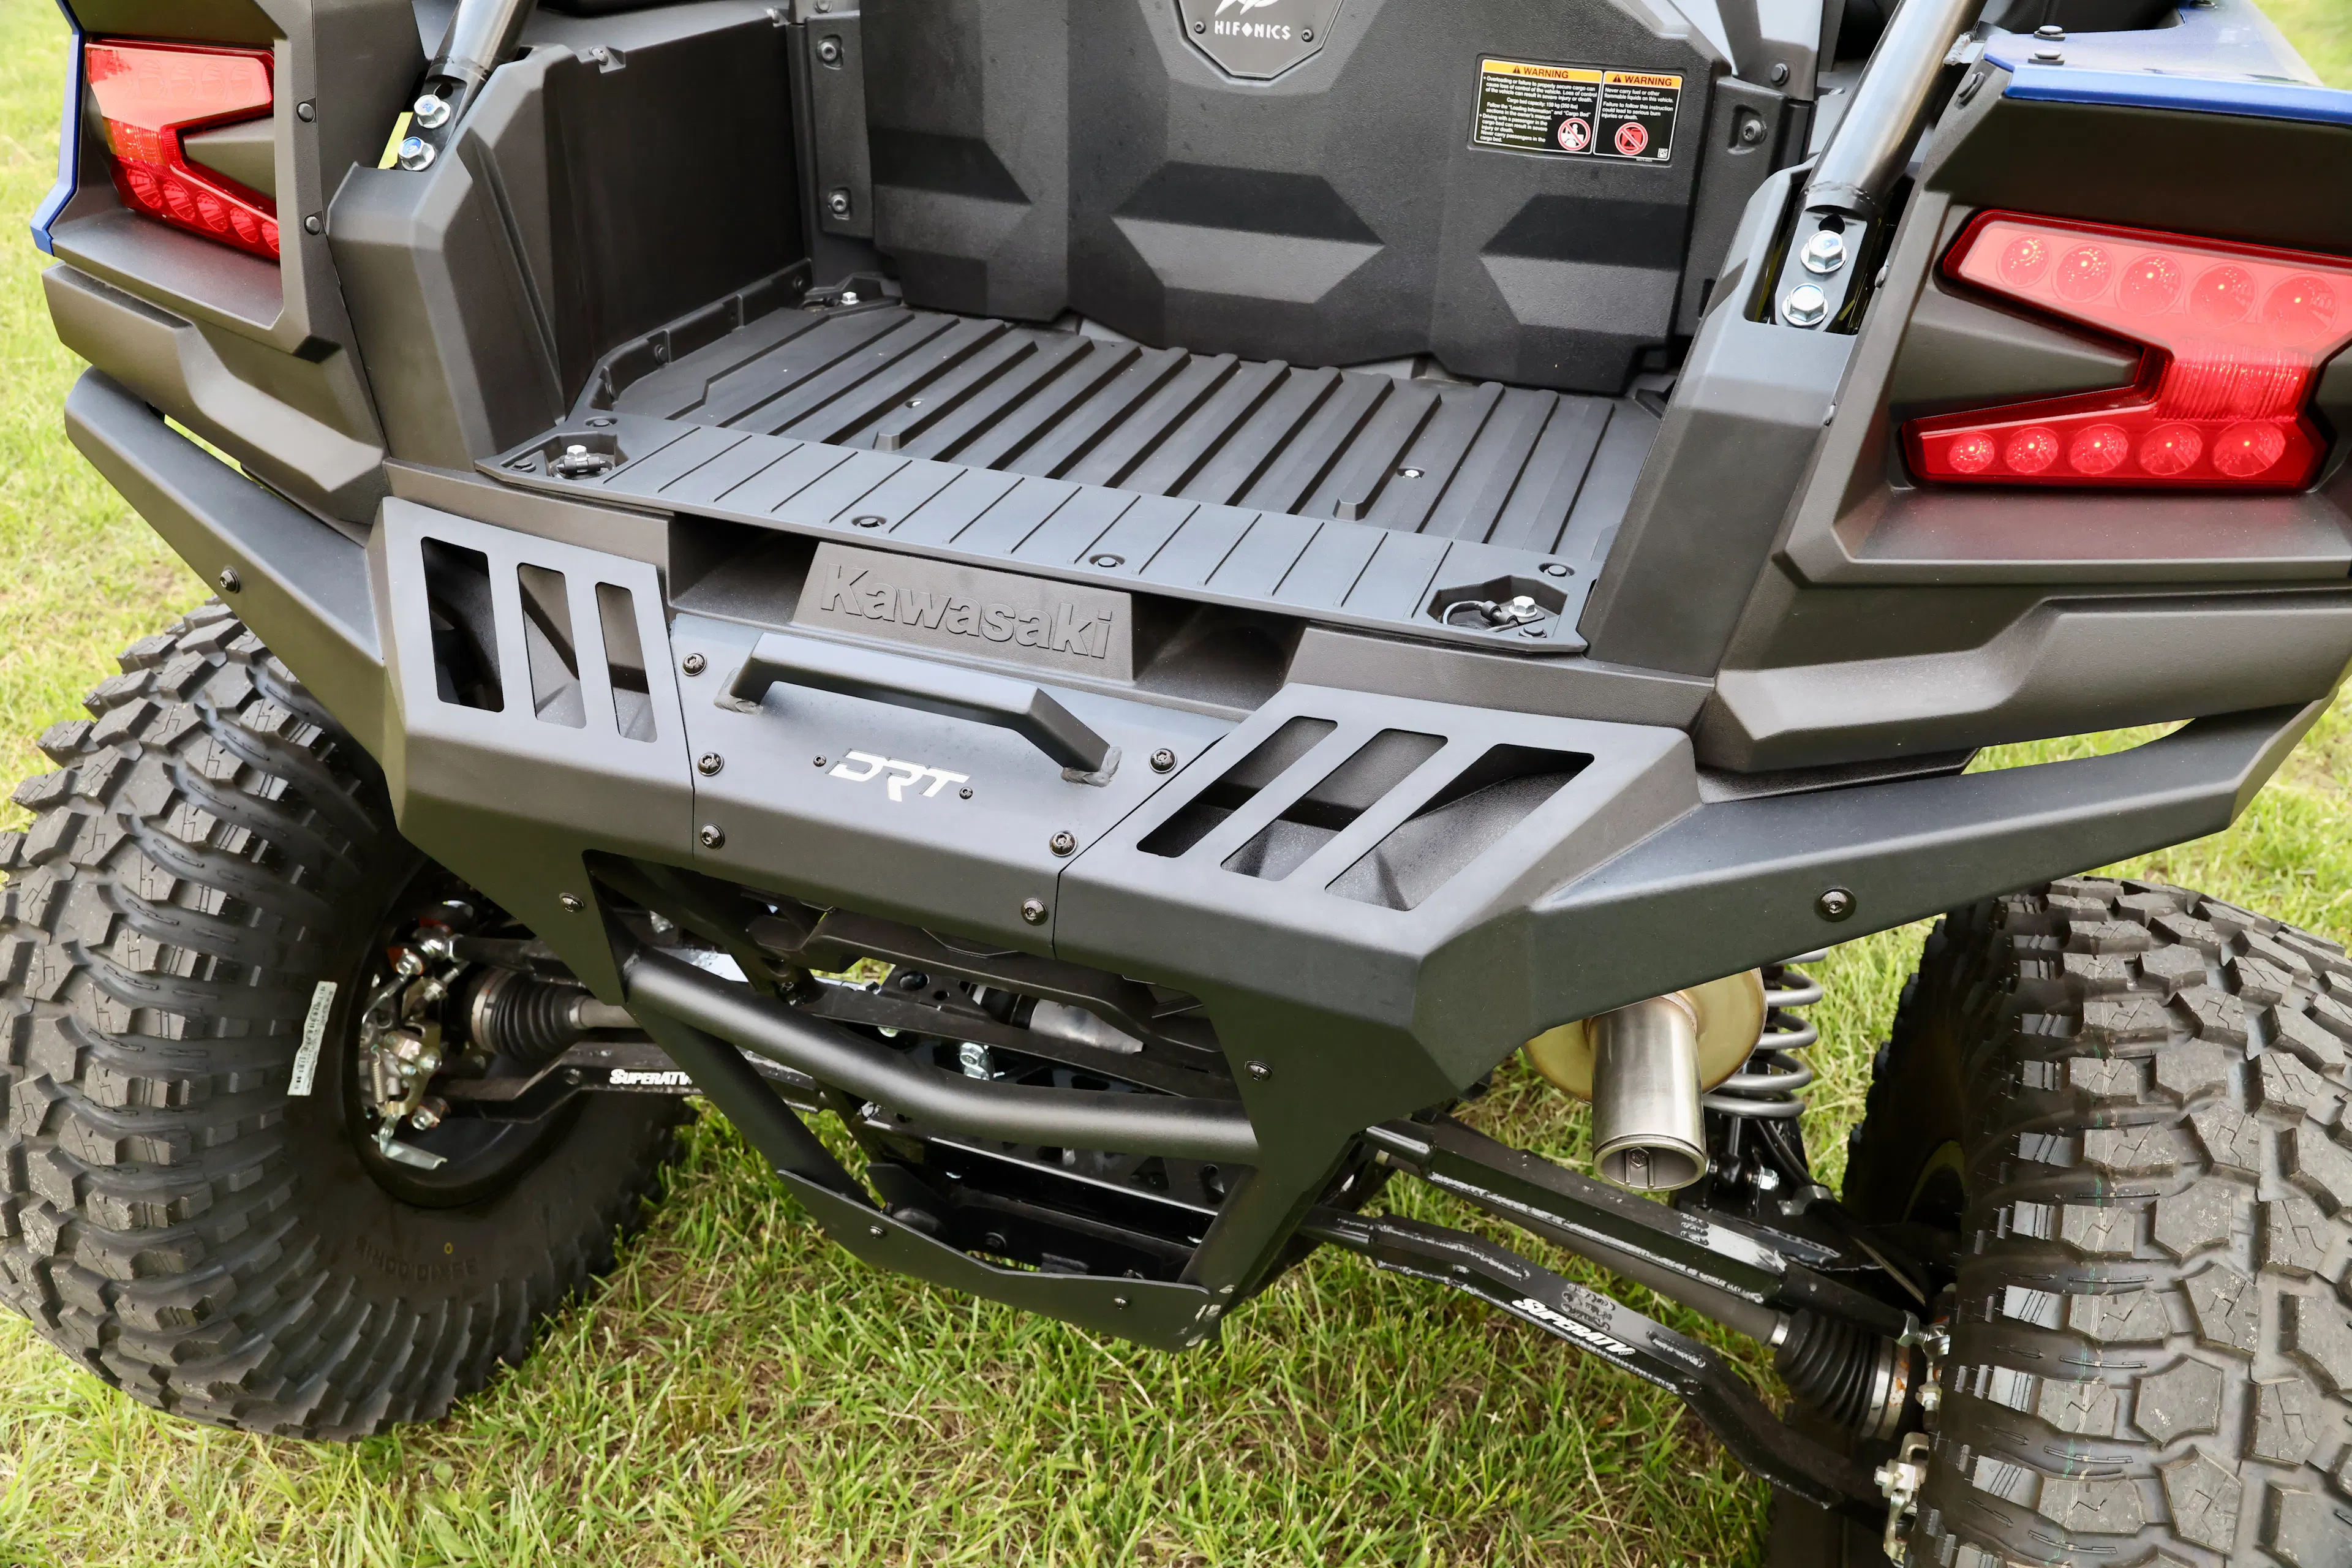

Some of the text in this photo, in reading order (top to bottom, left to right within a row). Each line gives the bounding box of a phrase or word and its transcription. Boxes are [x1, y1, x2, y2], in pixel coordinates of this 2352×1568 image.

[1524, 67, 1569, 79] WARNING
[1625, 75, 1672, 86] WARNING
[820, 563, 1113, 658] Kawasaki
[826, 748, 971, 802] DRT
